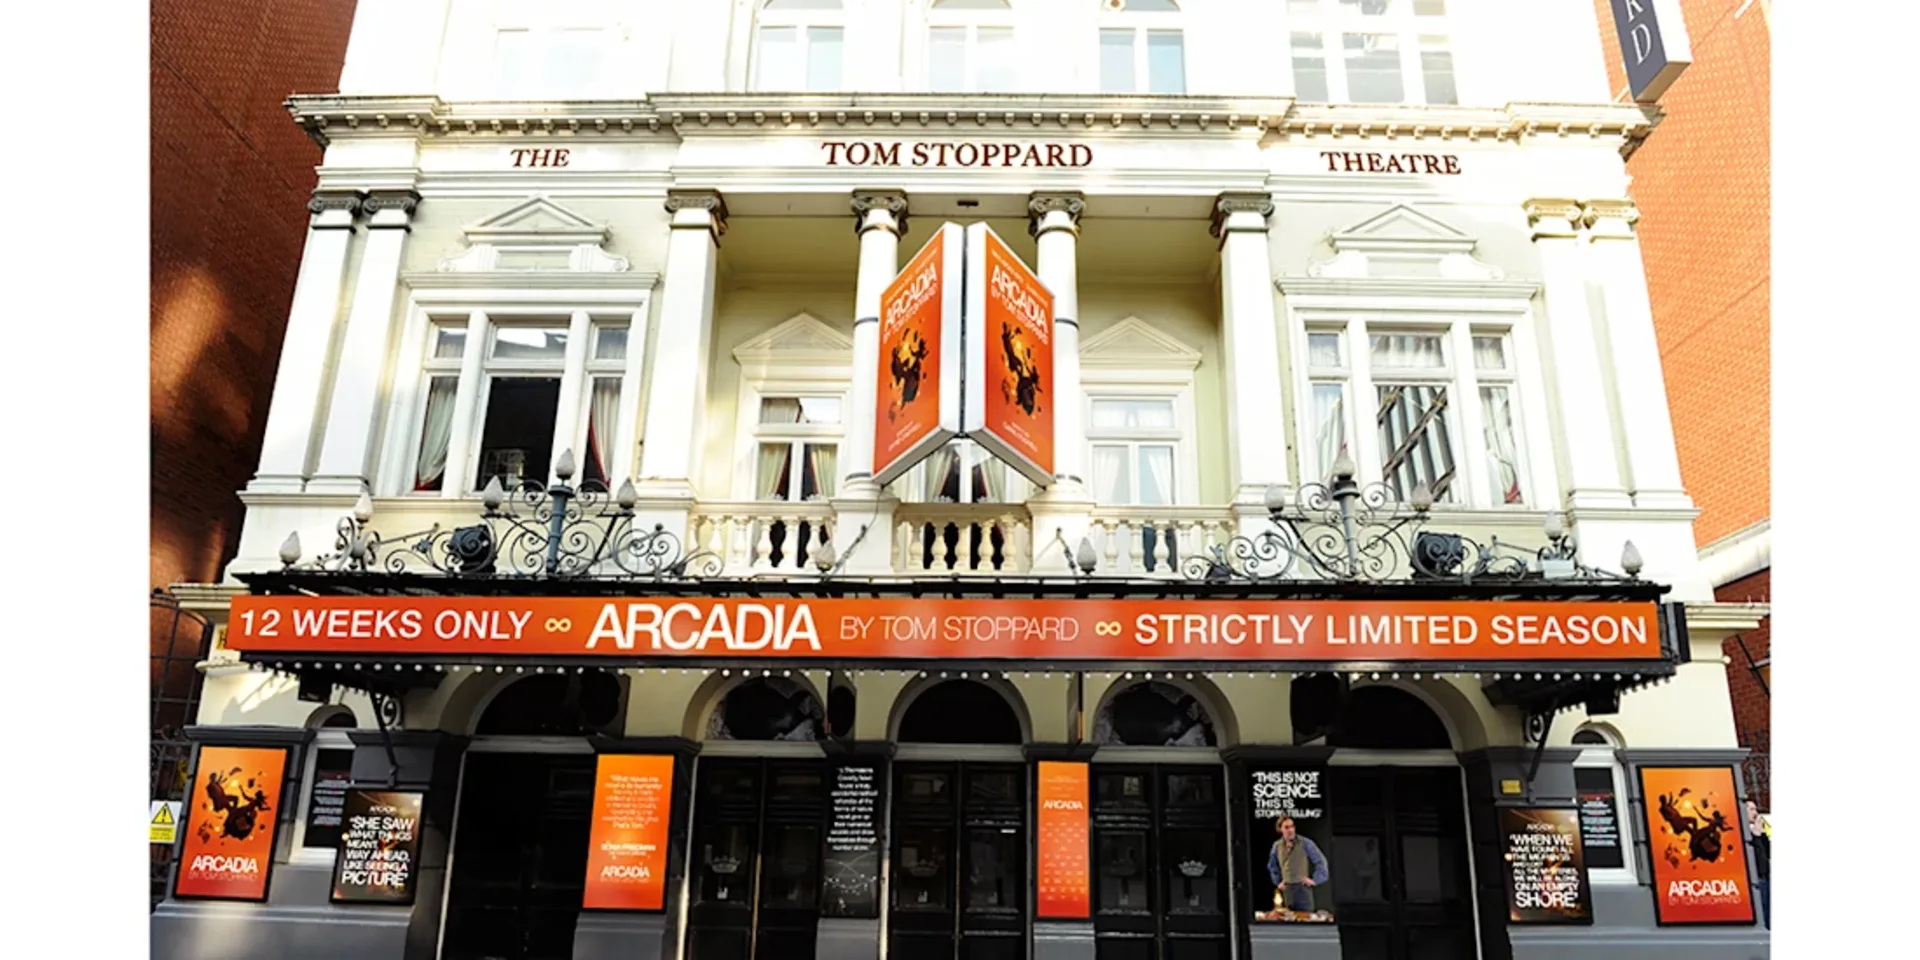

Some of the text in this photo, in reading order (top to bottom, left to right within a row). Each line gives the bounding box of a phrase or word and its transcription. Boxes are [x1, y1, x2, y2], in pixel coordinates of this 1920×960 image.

[509, 148, 570, 168] THE
[822, 142, 1093, 167] TOM STOPPARD
[1320, 151, 1462, 175] THEATRE
[883, 261, 937, 334] ARCADIA
[991, 264, 1049, 335] ARCADIA
[240, 609, 532, 639] 12 WEEKS ONLY
[585, 603, 822, 650] ARCADIA
[840, 616, 1079, 642] BY TOM STOPPARD
[1135, 614, 1647, 646] STRICTLY LIMITED SEASON
[1282, 771, 1294, 783] IS
[1294, 771, 1320, 783] NOT
[1043, 800, 1084, 810] ARCADIA
[1255, 798, 1281, 809] THIS
[382, 816, 415, 831] SAW
[1551, 833, 1574, 846] WE
[346, 849, 370, 860] WAY
[190, 855, 259, 874] ARCADIA
[343, 860, 363, 870] LIKE
[601, 865, 650, 878] ARCADIA
[1668, 879, 1740, 897] ARCADIA
